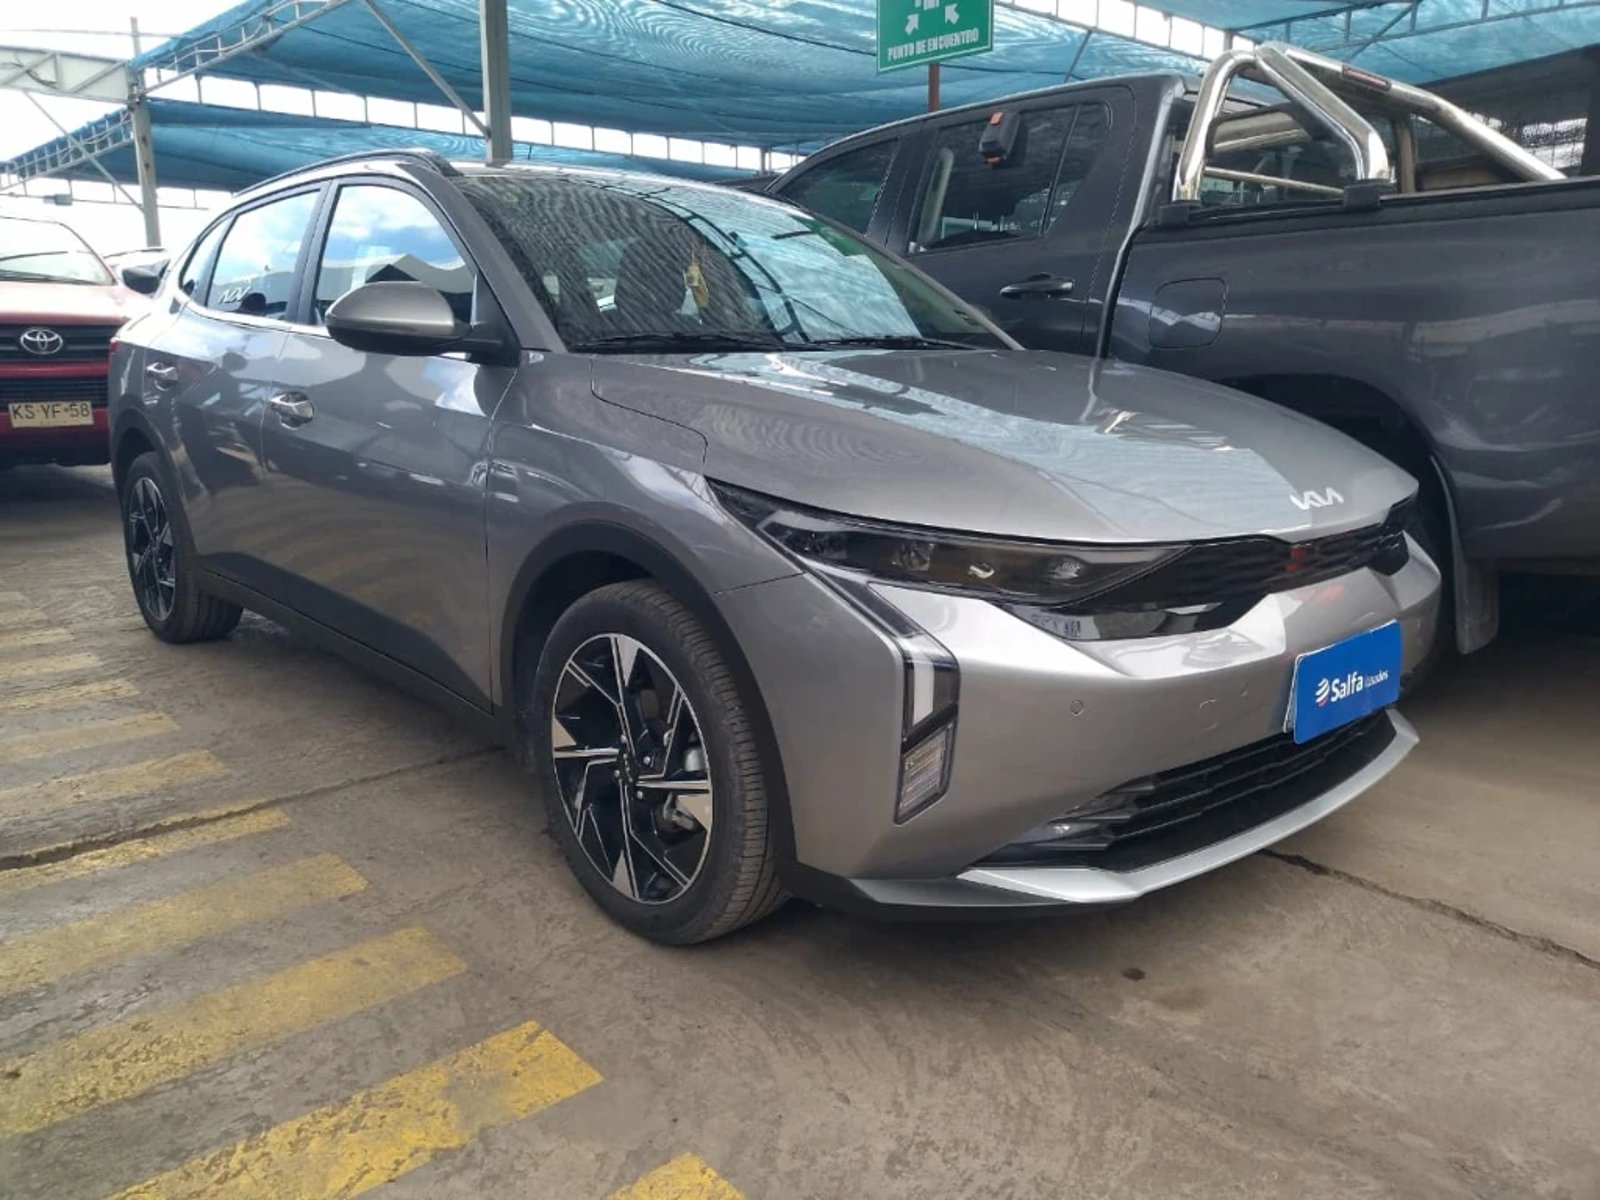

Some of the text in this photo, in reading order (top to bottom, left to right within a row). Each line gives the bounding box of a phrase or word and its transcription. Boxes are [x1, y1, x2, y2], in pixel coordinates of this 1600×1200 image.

[887, 27, 979, 61] PUNTO DE ENCUENTRO
[1330, 671, 1364, 702] Salfa
